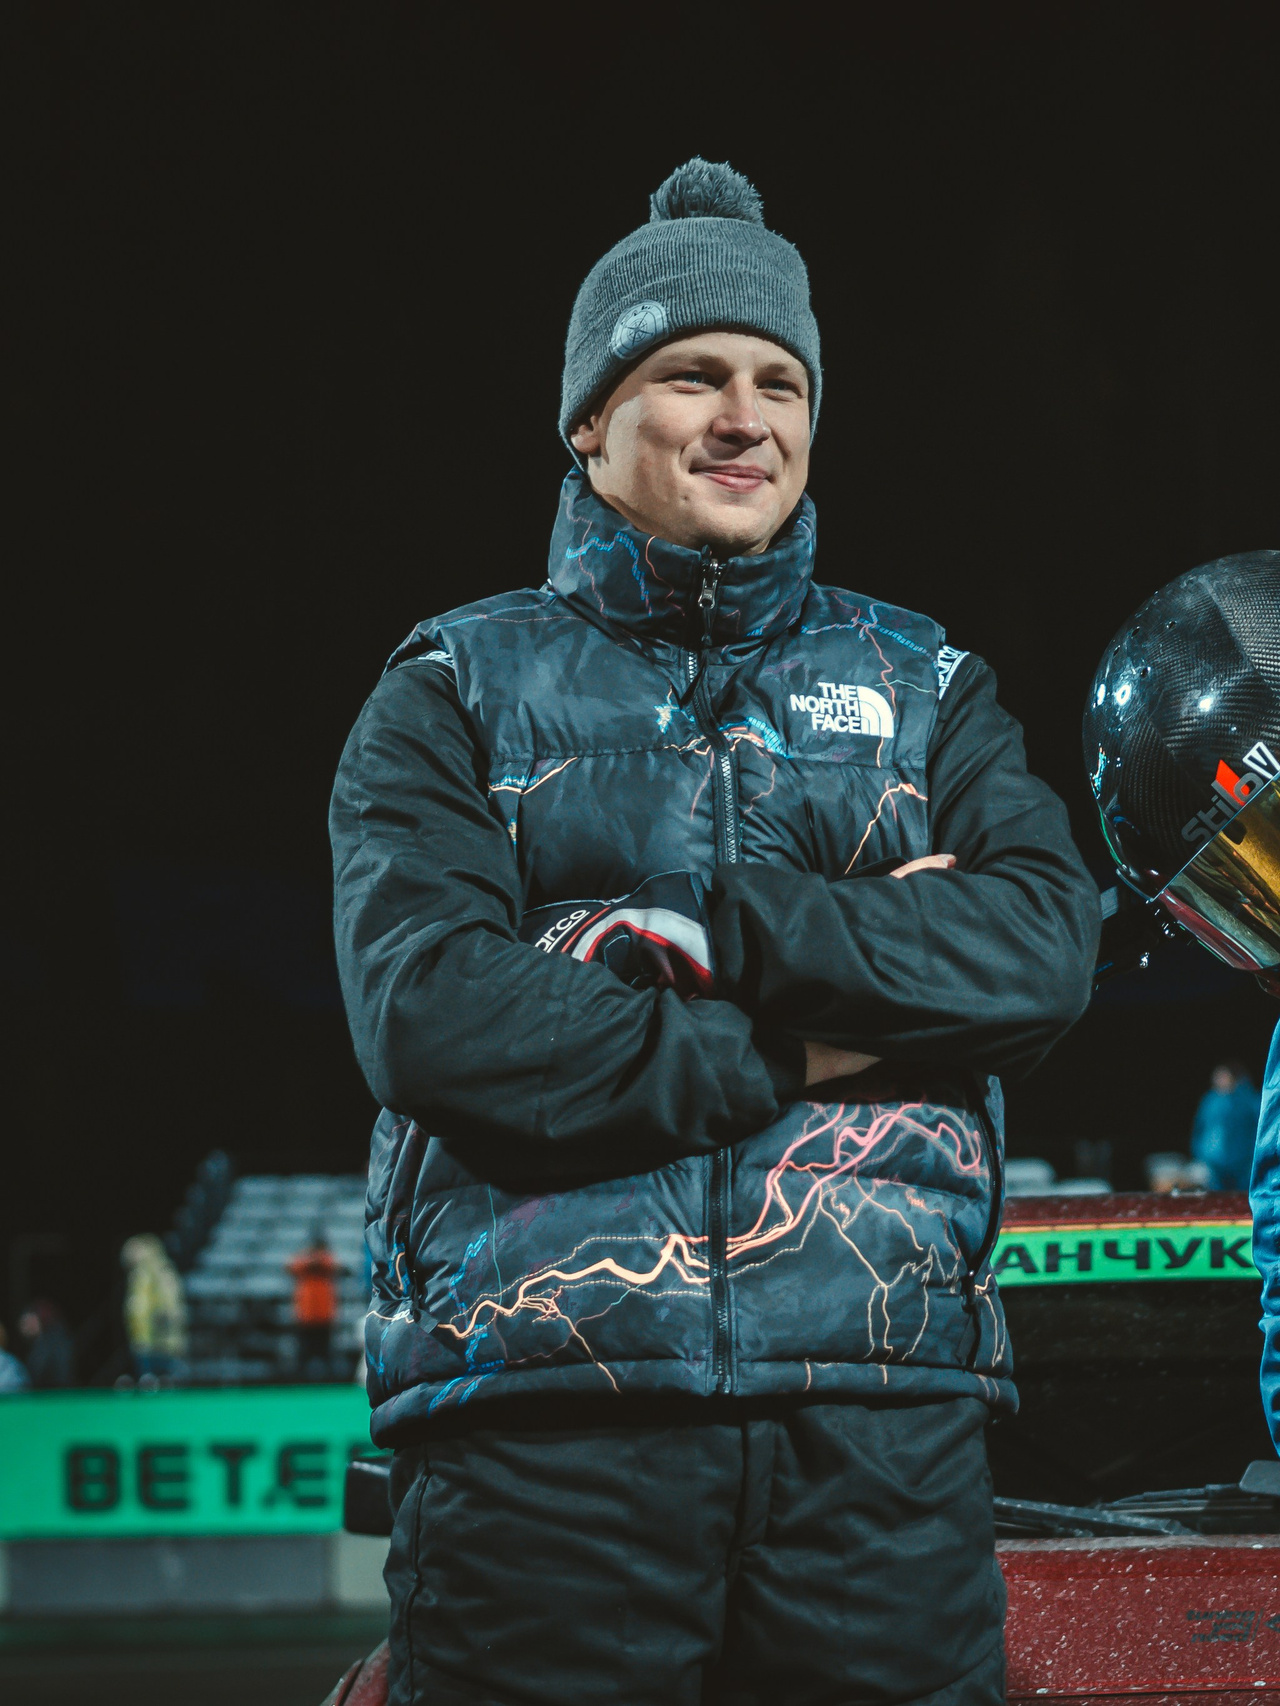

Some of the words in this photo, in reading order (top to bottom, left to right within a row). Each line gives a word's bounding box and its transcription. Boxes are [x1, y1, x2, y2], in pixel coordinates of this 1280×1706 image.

[817, 682, 857, 700] THE
[790, 694, 860, 717] NORTH
[811, 713, 862, 734] FACE
[534, 909, 590, 954] arco
